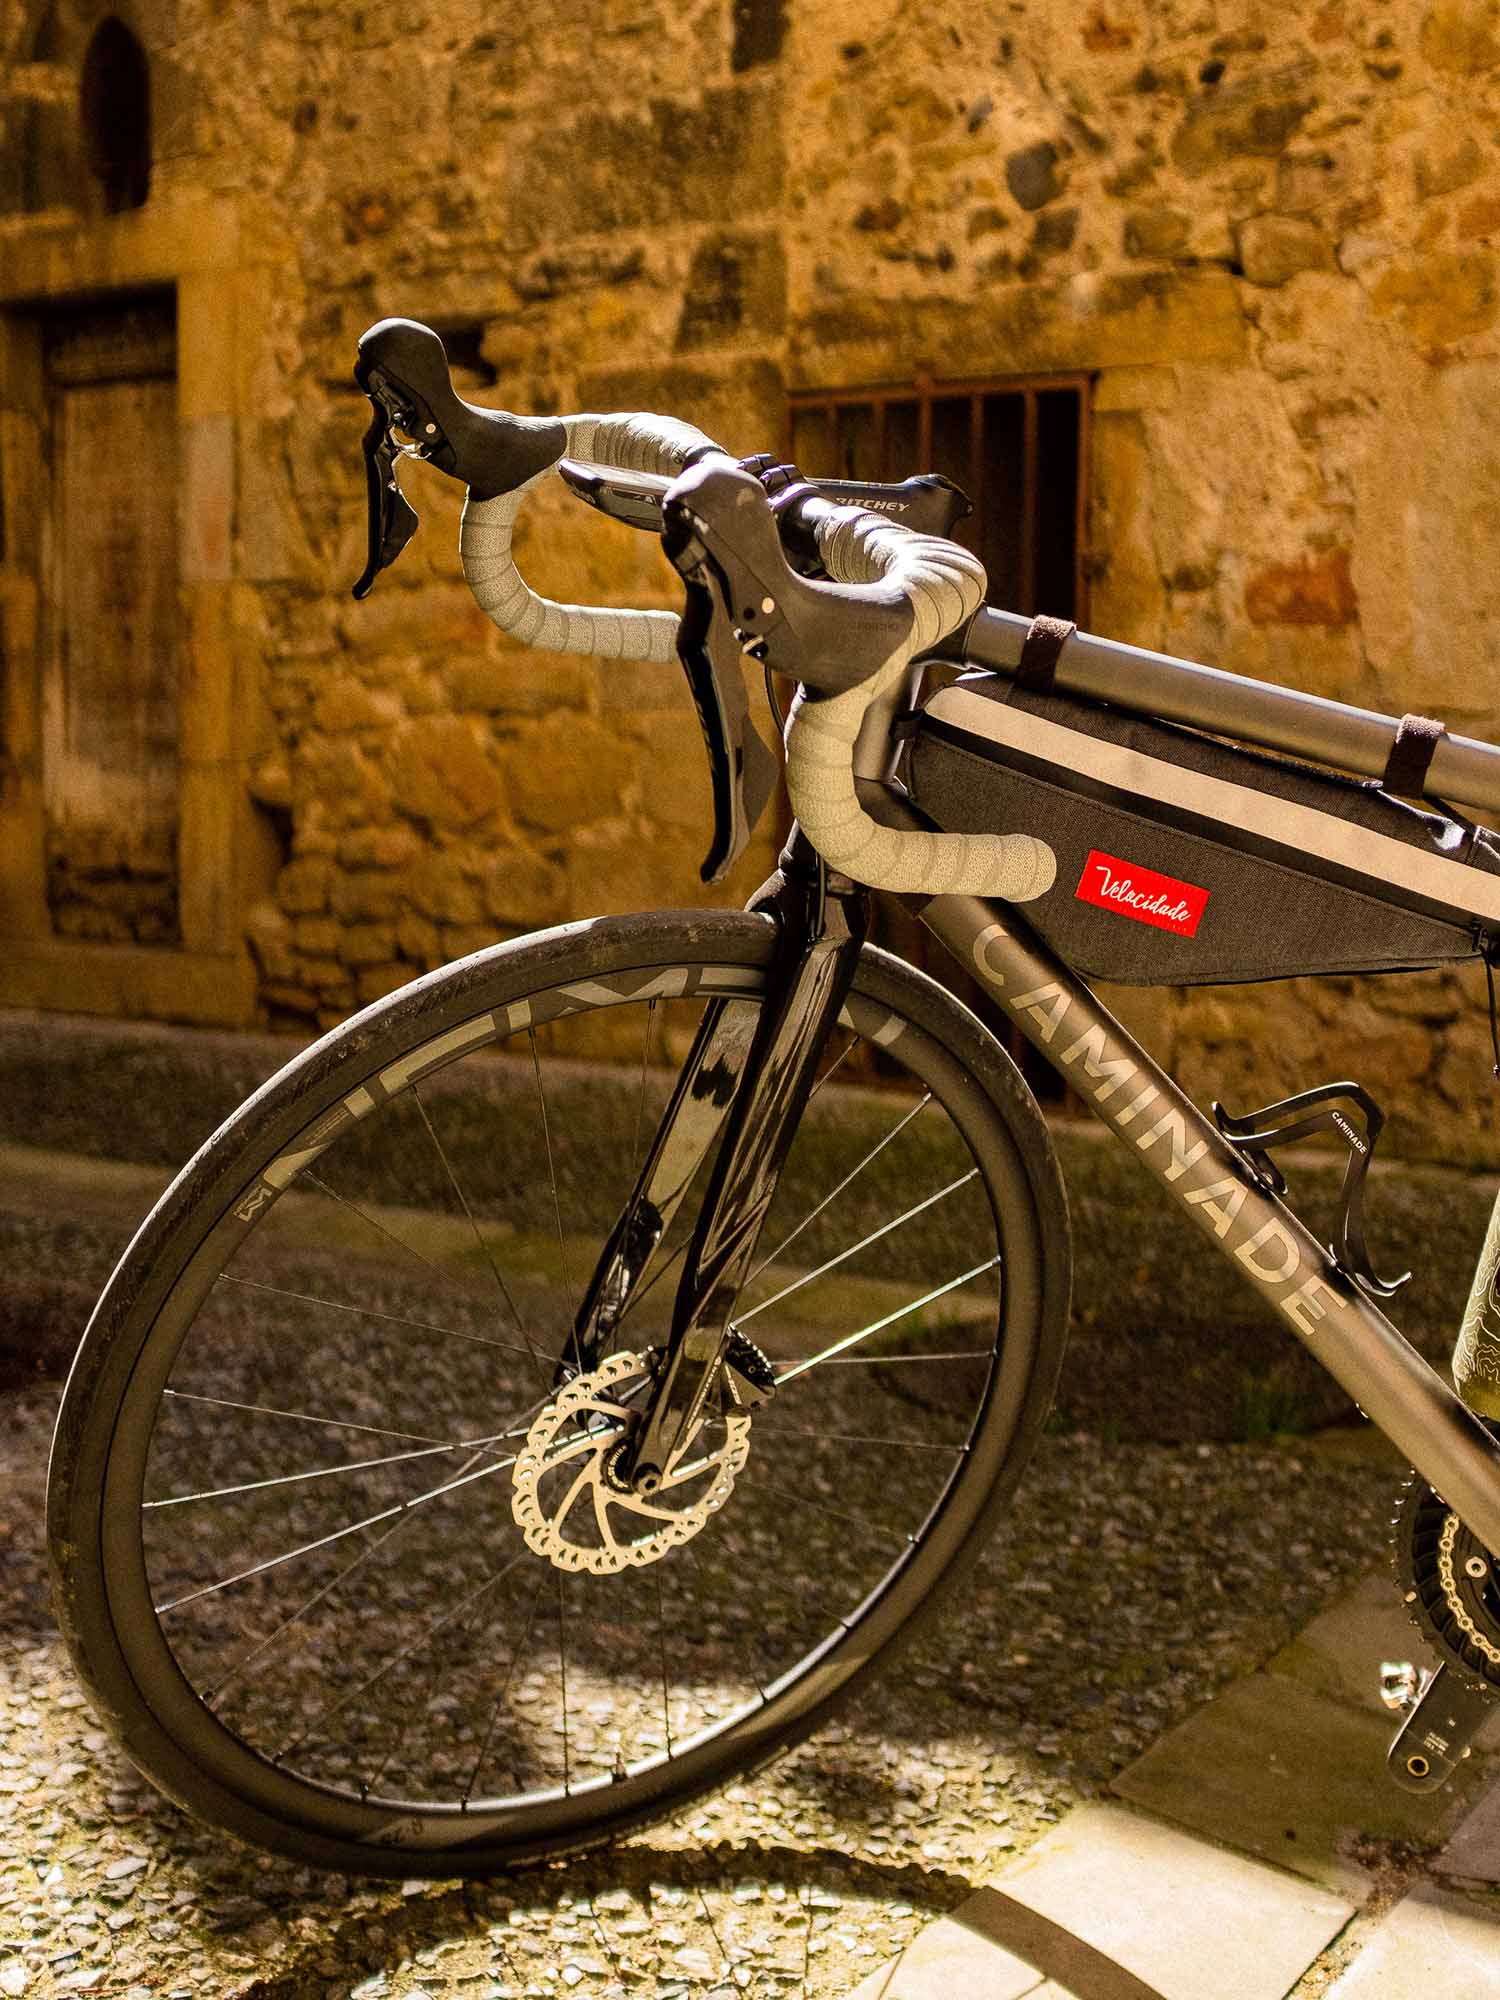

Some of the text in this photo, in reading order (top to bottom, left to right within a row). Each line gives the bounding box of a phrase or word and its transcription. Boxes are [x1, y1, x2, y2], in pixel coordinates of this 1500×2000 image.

[1096, 866, 1191, 922] Velocidade
[973, 924, 1348, 1336] CAMINADE
[1332, 1111, 1368, 1155] CAMINADE
